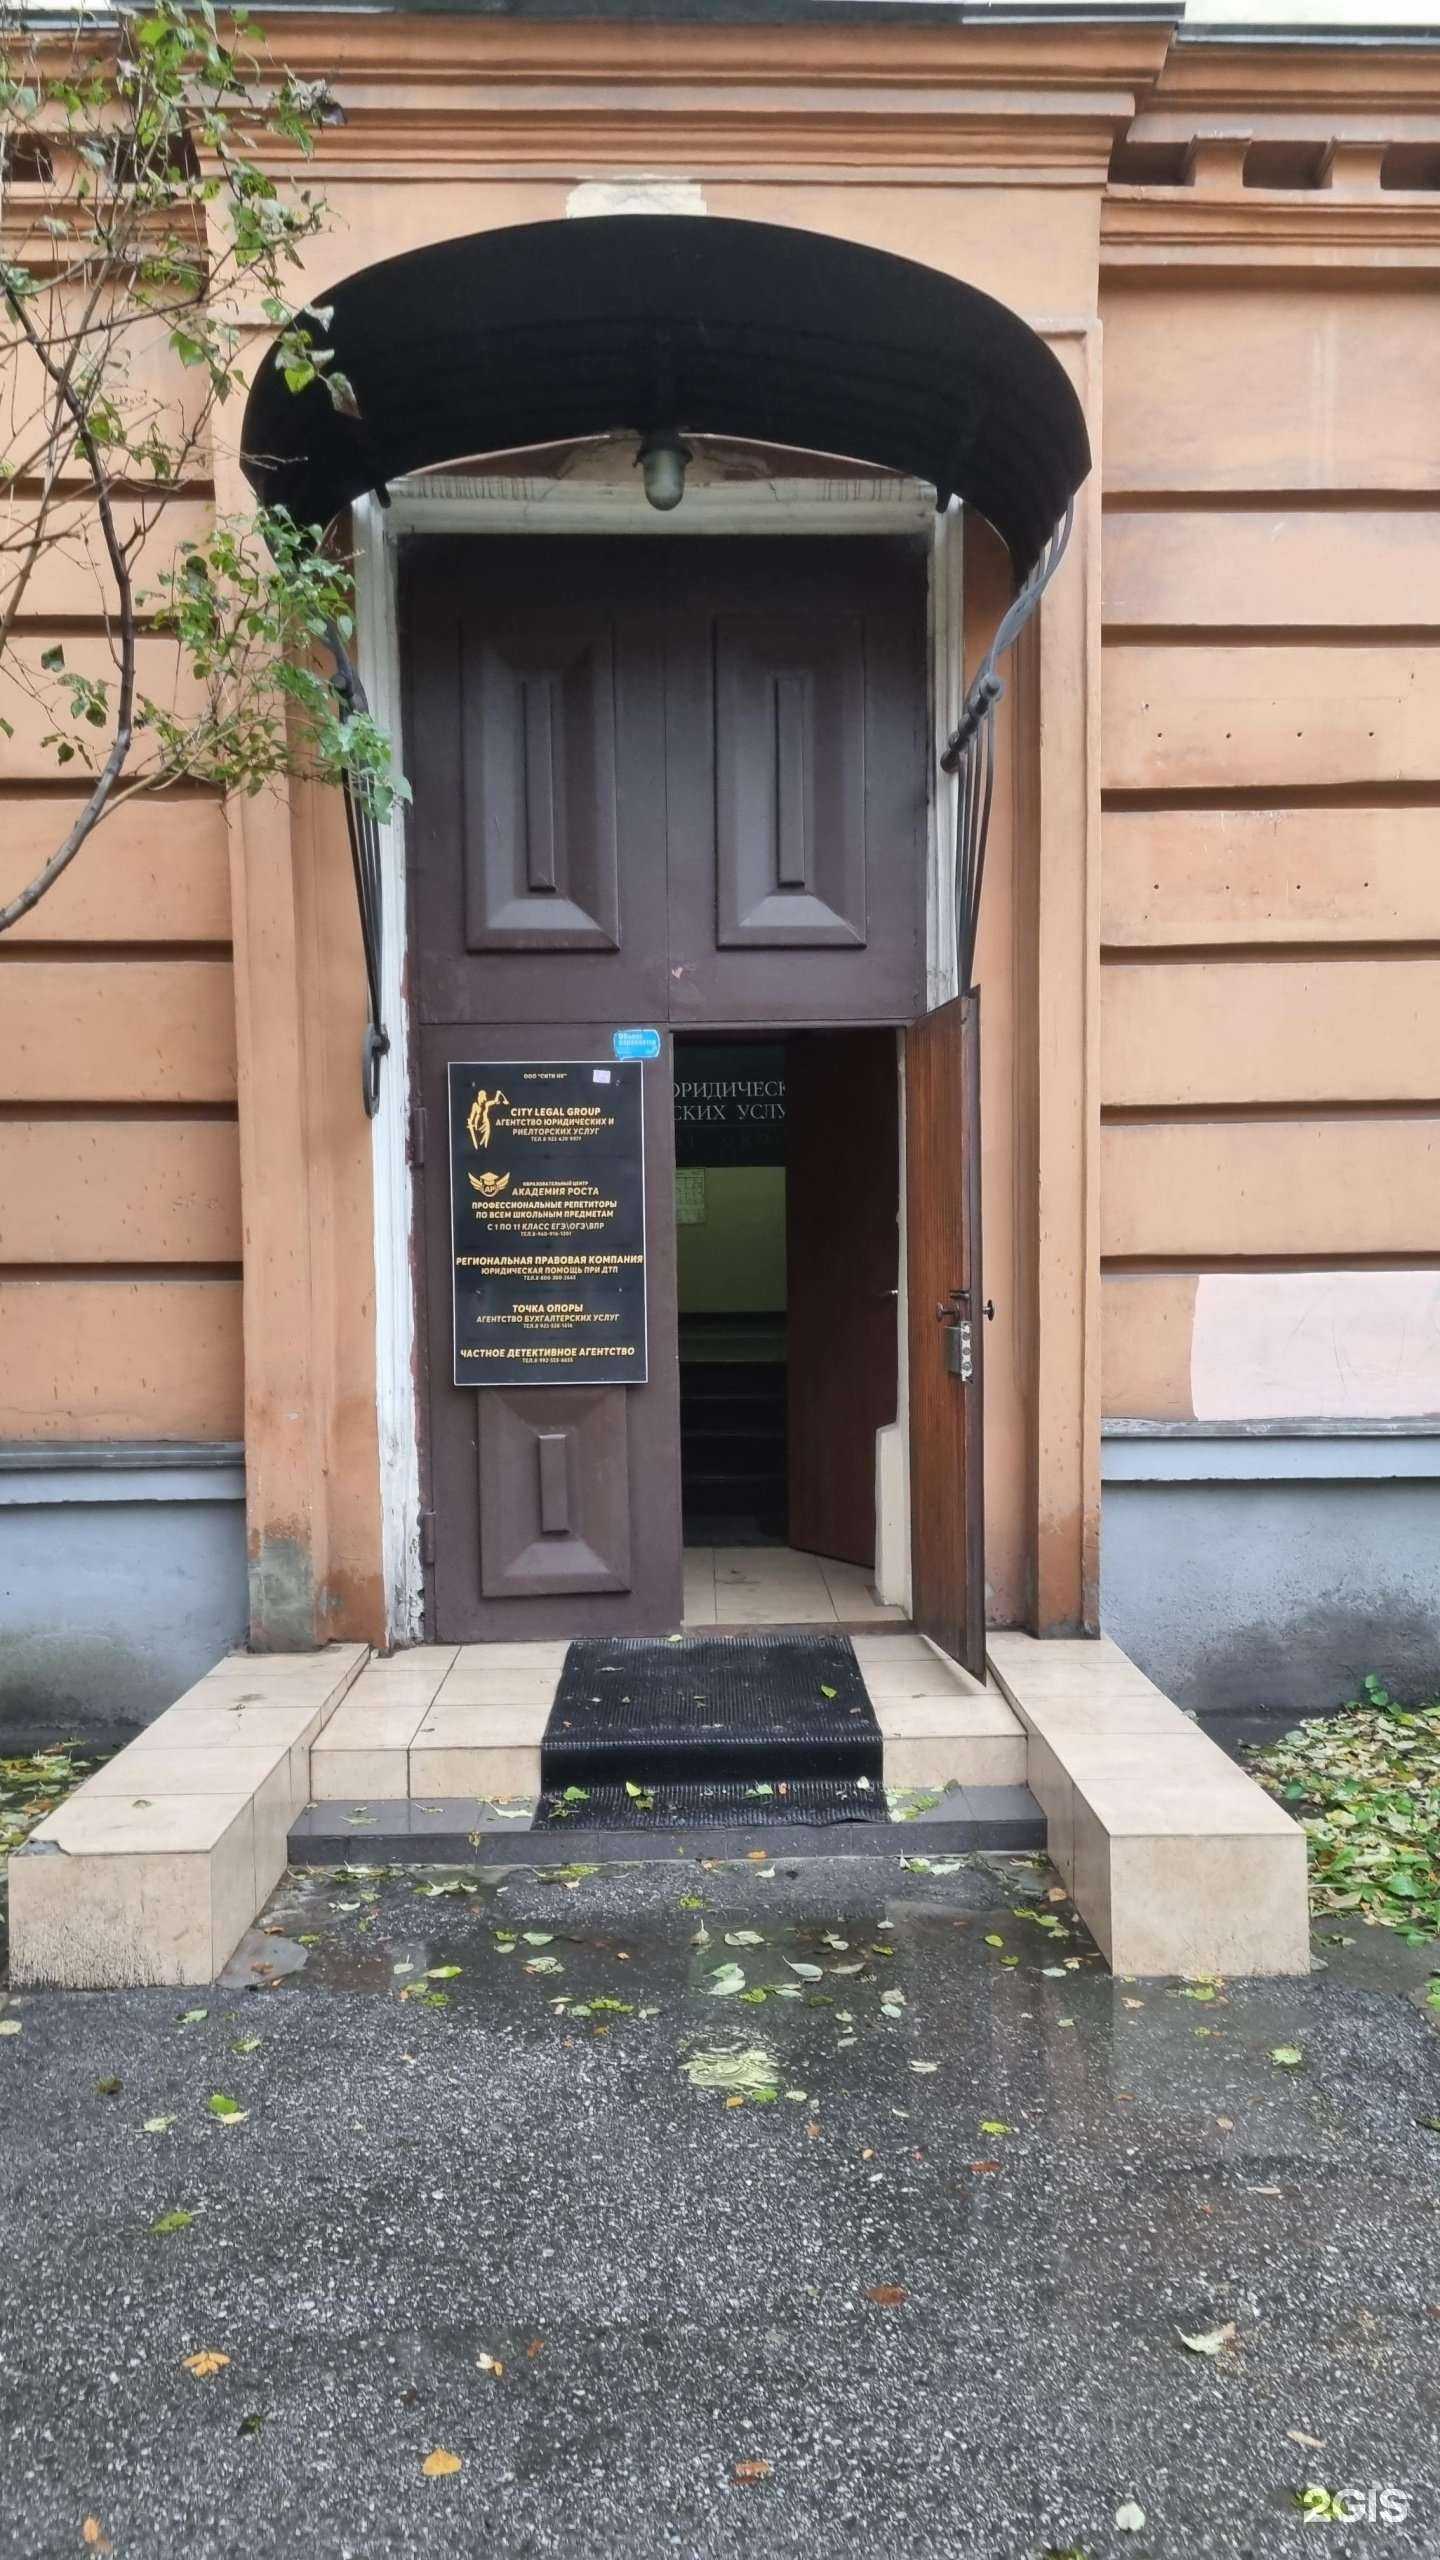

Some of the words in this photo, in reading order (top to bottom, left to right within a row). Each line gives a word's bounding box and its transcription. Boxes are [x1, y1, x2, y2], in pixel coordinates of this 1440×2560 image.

[510, 1107, 533, 1117] CITY
[534, 1107, 565, 1117] LEGAL
[567, 1106, 601, 1116] GROUP
[495, 1118, 542, 1127] АГЕНТСТВО
[543, 1118, 608, 1127] ЮРИДИЧЕСКИХ
[608, 1118, 615, 1126] И
[572, 1127, 600, 1136] УСЛУГ
[511, 1187, 566, 1197] АКАДЕМИЯ
[567, 1187, 600, 1196] РОСТА
[471, 1201, 563, 1210] ПРОФЕССИОНАЛЬНЫЕ
[564, 1200, 617, 1209] РЕПЕТИТОРЫ
[475, 1211, 488, 1219] ПО
[489, 1211, 512, 1219] ВСЕМ
[513, 1210, 563, 1219] ШКОЛЬНЫМ
[564, 1210, 614, 1219] ПРЕДМЕТАМ
[500, 1223, 512, 1231] ПО
[522, 1223, 550, 1231] КЛАСС
[456, 1256, 533, 1266] РЕГИОНАЛЬНАЯ
[535, 1255, 587, 1265] ПРАВОВАЯ
[588, 1254, 644, 1264] КОМПАНИЯ
[481, 1267, 544, 1275] ЮРИДИЧЕСКАЯ
[545, 1266, 583, 1275] ПОМОЩЬ
[584, 1266, 600, 1274] ПРИ
[601, 1266, 619, 1274] ДТП
[512, 1304, 545, 1313] ТОЧКА
[546, 1303, 584, 1313] ОПОРЫ
[476, 1315, 523, 1323] АГЕНТСТВО
[524, 1314, 592, 1323] БУХГАЛТЕРСКИХ
[593, 1313, 620, 1322] УСЛУГ
[460, 1349, 506, 1358] ЧАСТНОЕ
[507, 1348, 578, 1358] ДЕТЕКТИВНОЕ
[579, 1347, 636, 1357] АГЕНТСТВО
